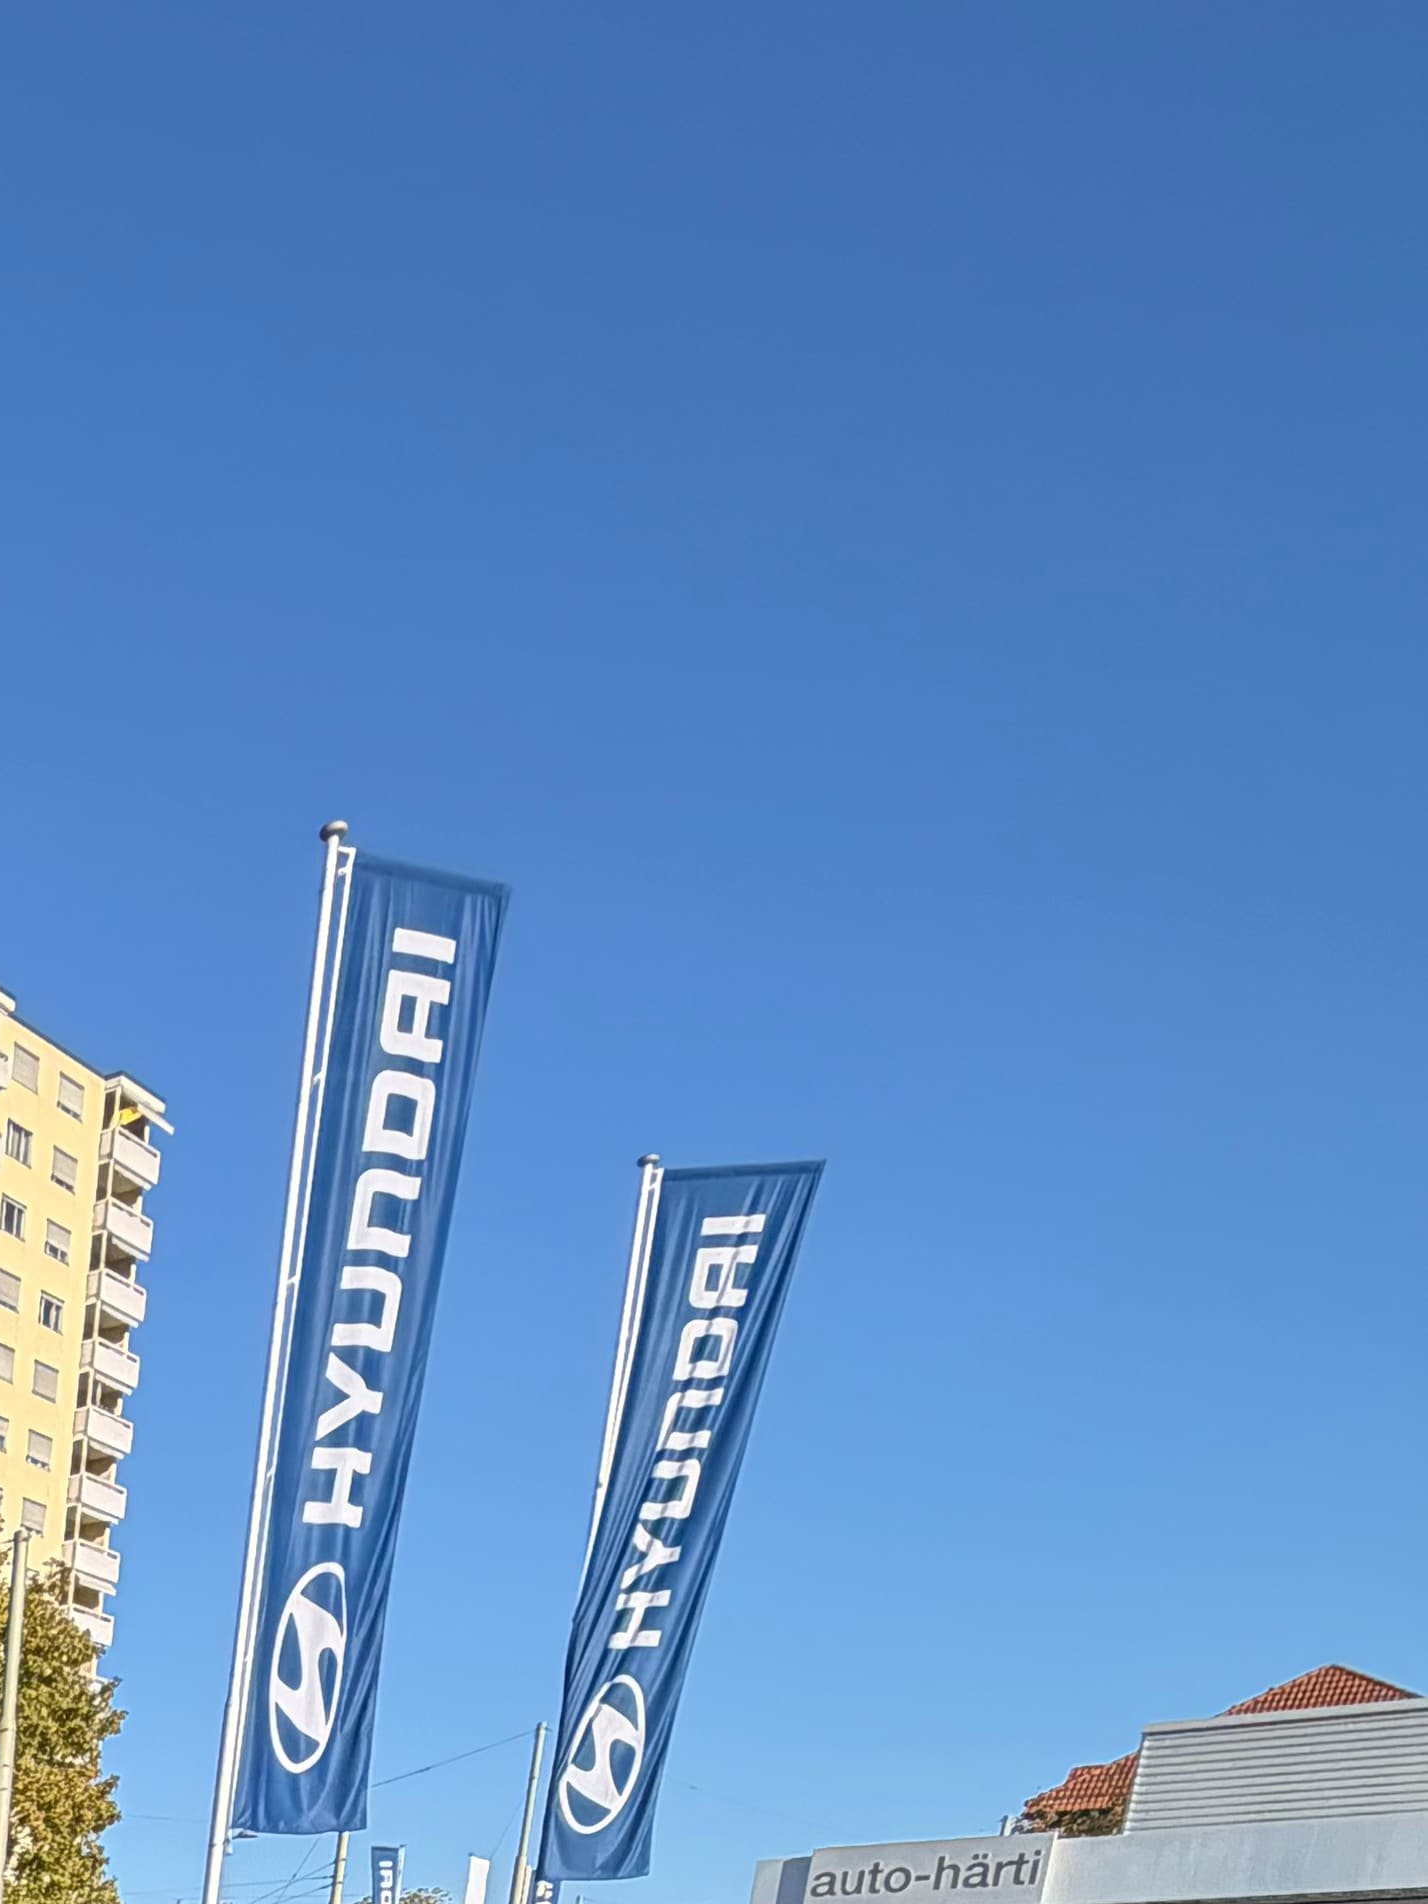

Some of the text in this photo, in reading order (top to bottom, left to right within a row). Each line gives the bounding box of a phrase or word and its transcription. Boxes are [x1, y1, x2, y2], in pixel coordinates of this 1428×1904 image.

[302, 927, 457, 1529] HYUNDAI
[608, 1211, 766, 1650] HYUNDAI
[809, 1849, 1042, 1898] auto-härti
